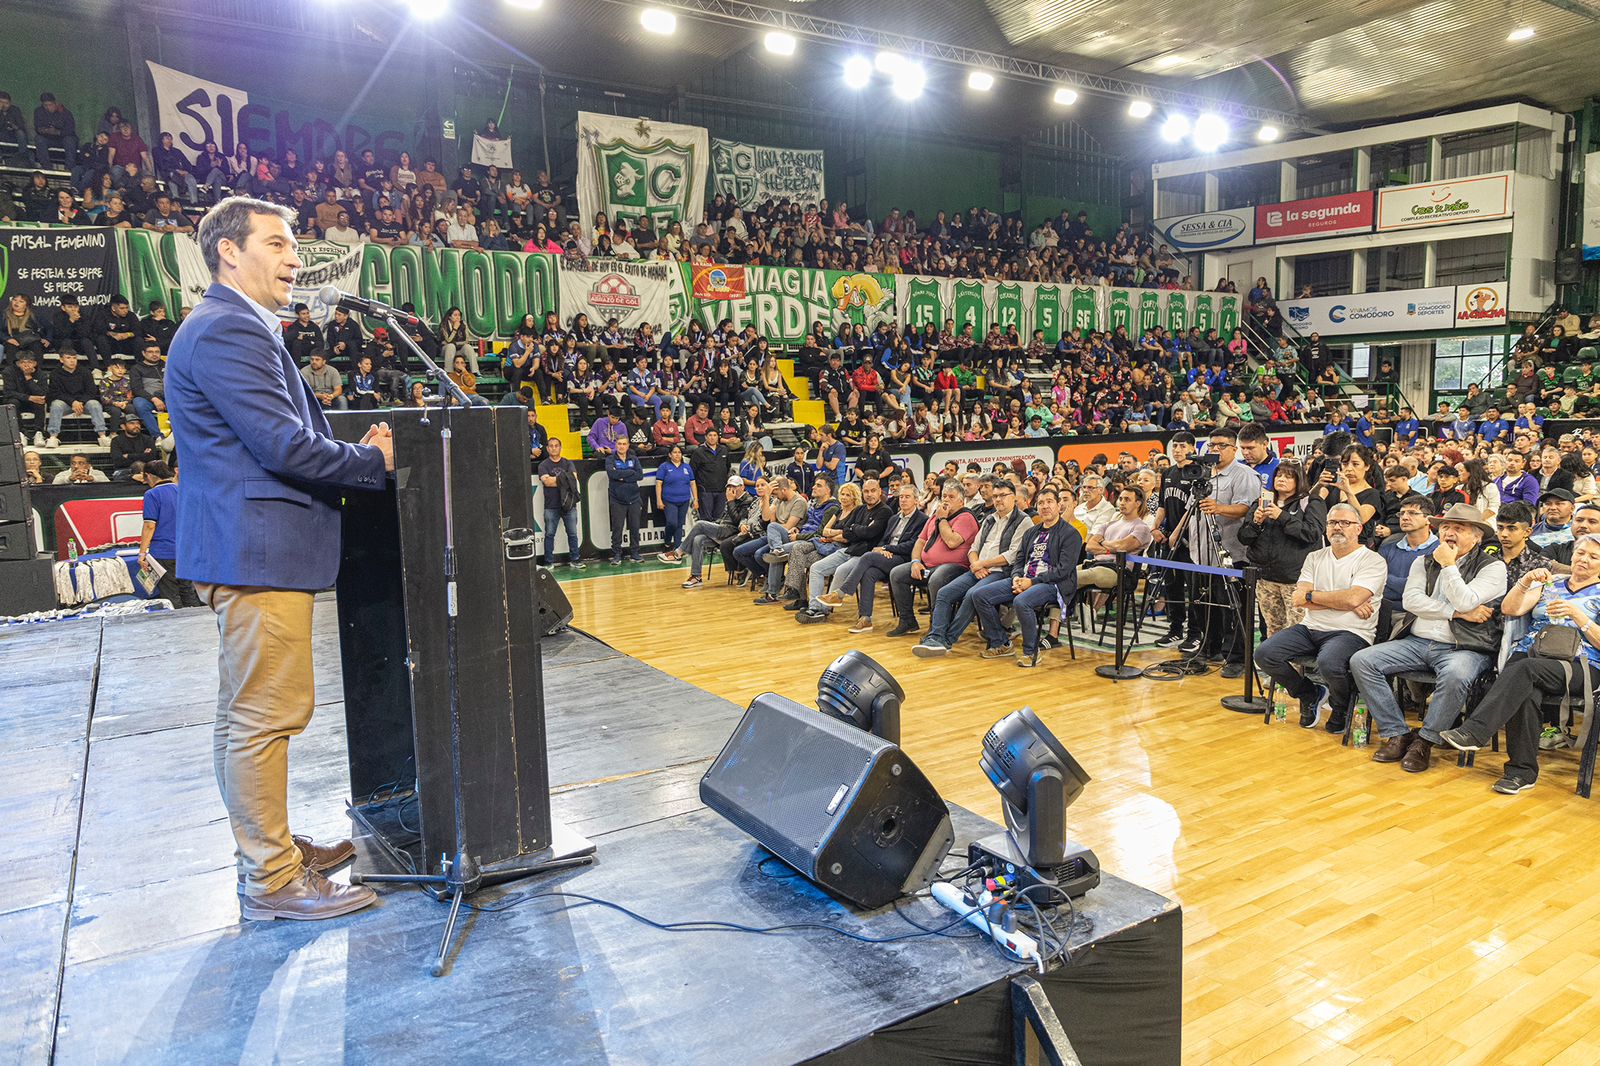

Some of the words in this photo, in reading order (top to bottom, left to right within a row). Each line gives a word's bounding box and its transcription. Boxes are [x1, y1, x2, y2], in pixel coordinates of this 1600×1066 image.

[1286, 210, 1298, 222] la
[1301, 202, 1361, 220] segunda
[1181, 222, 1206, 232] SESSA
[1208, 220, 1215, 229] &
[1217, 219, 1232, 228] CIA
[11, 234, 52, 251] FUTSAL
[55, 233, 105, 251] FEMENINO
[17, 267, 29, 280] SE
[66, 267, 78, 279] SE
[79, 267, 103, 280] SUFRE
[744, 266, 829, 301] MAGIA
[43, 282, 54, 293] SE
[56, 281, 84, 294] PIERDE
[700, 293, 833, 340] VERDE
[915, 305, 934, 327] 15
[1001, 306, 1017, 327] 12
[1043, 308, 1053, 328] 5
[1349, 310, 1395, 320] COMODORO
